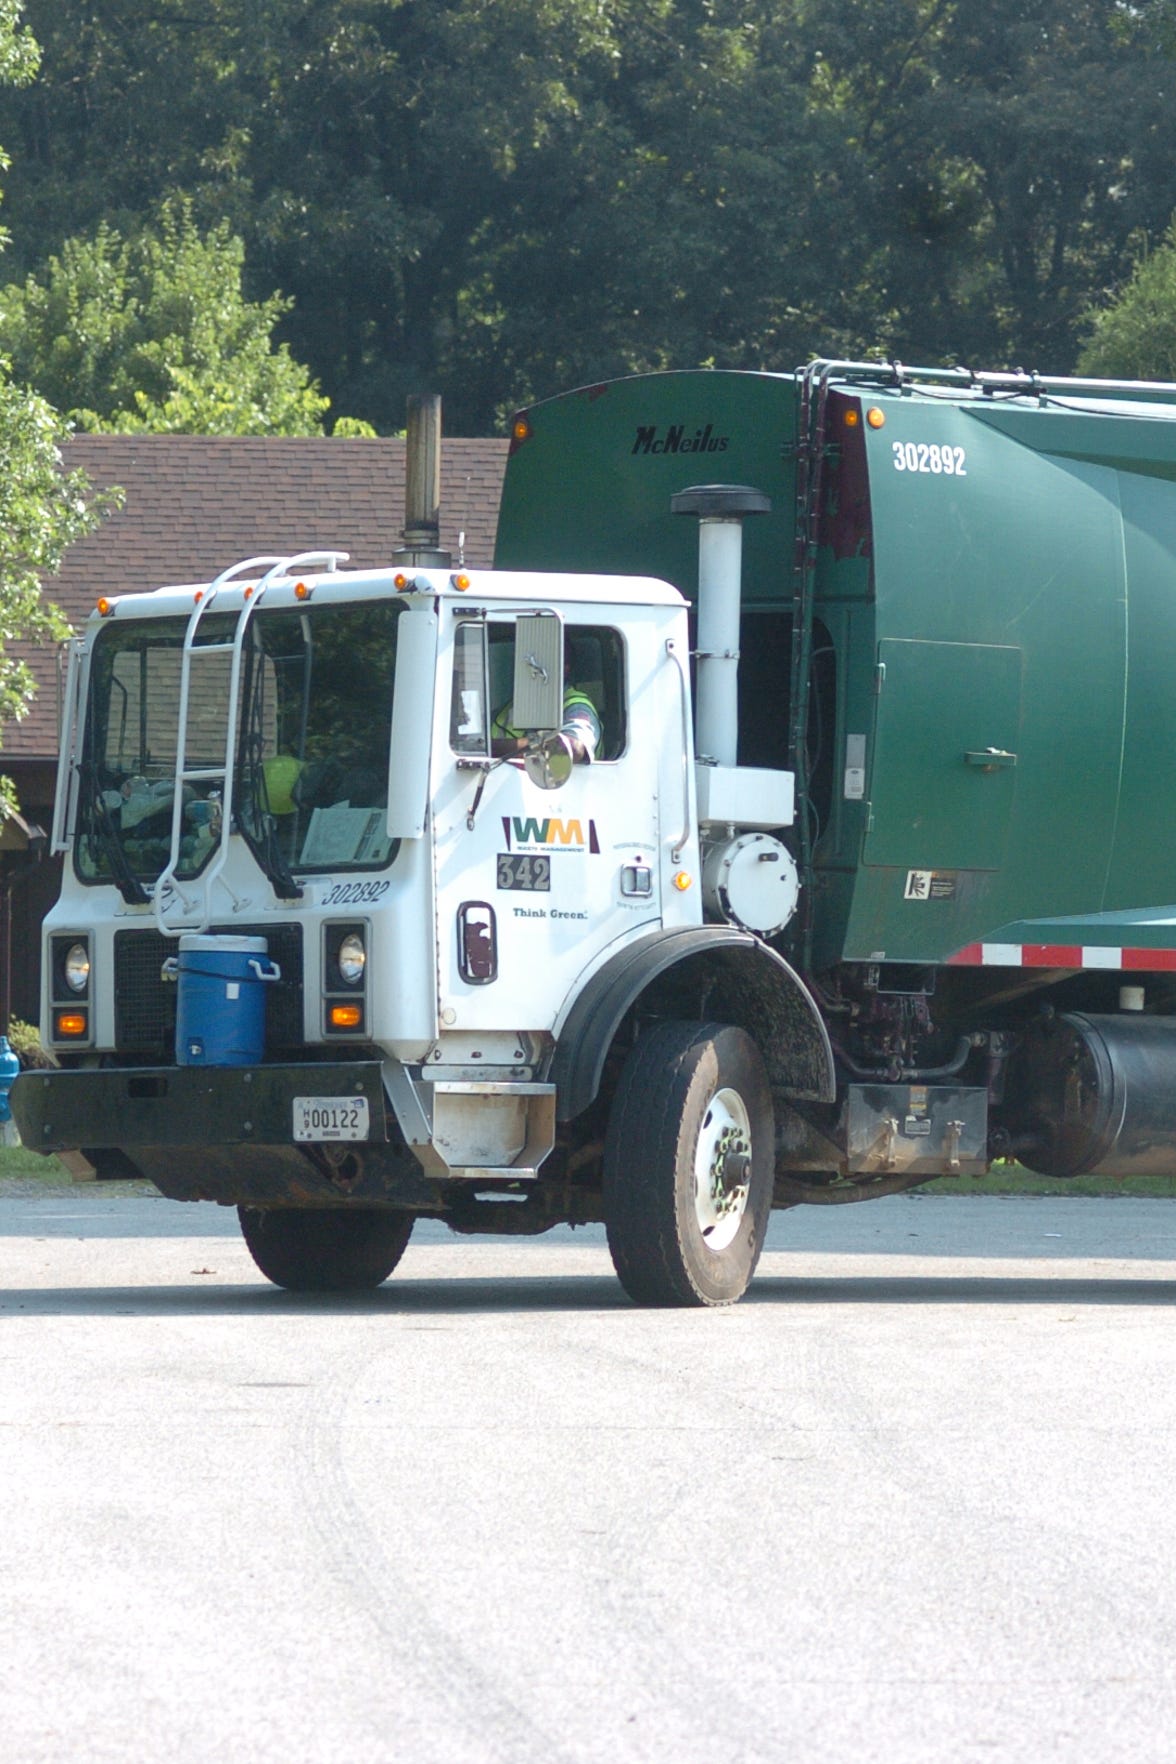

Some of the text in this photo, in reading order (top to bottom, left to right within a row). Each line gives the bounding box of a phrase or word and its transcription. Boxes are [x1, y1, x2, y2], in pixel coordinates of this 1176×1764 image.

[630, 424, 730, 456] McNeilus
[892, 441, 967, 476] 302892
[512, 816, 584, 845] WM
[498, 856, 549, 889] 342
[321, 880, 391, 906] 302892
[512, 907, 547, 919] Think
[311, 1109, 359, 1129] 00122
